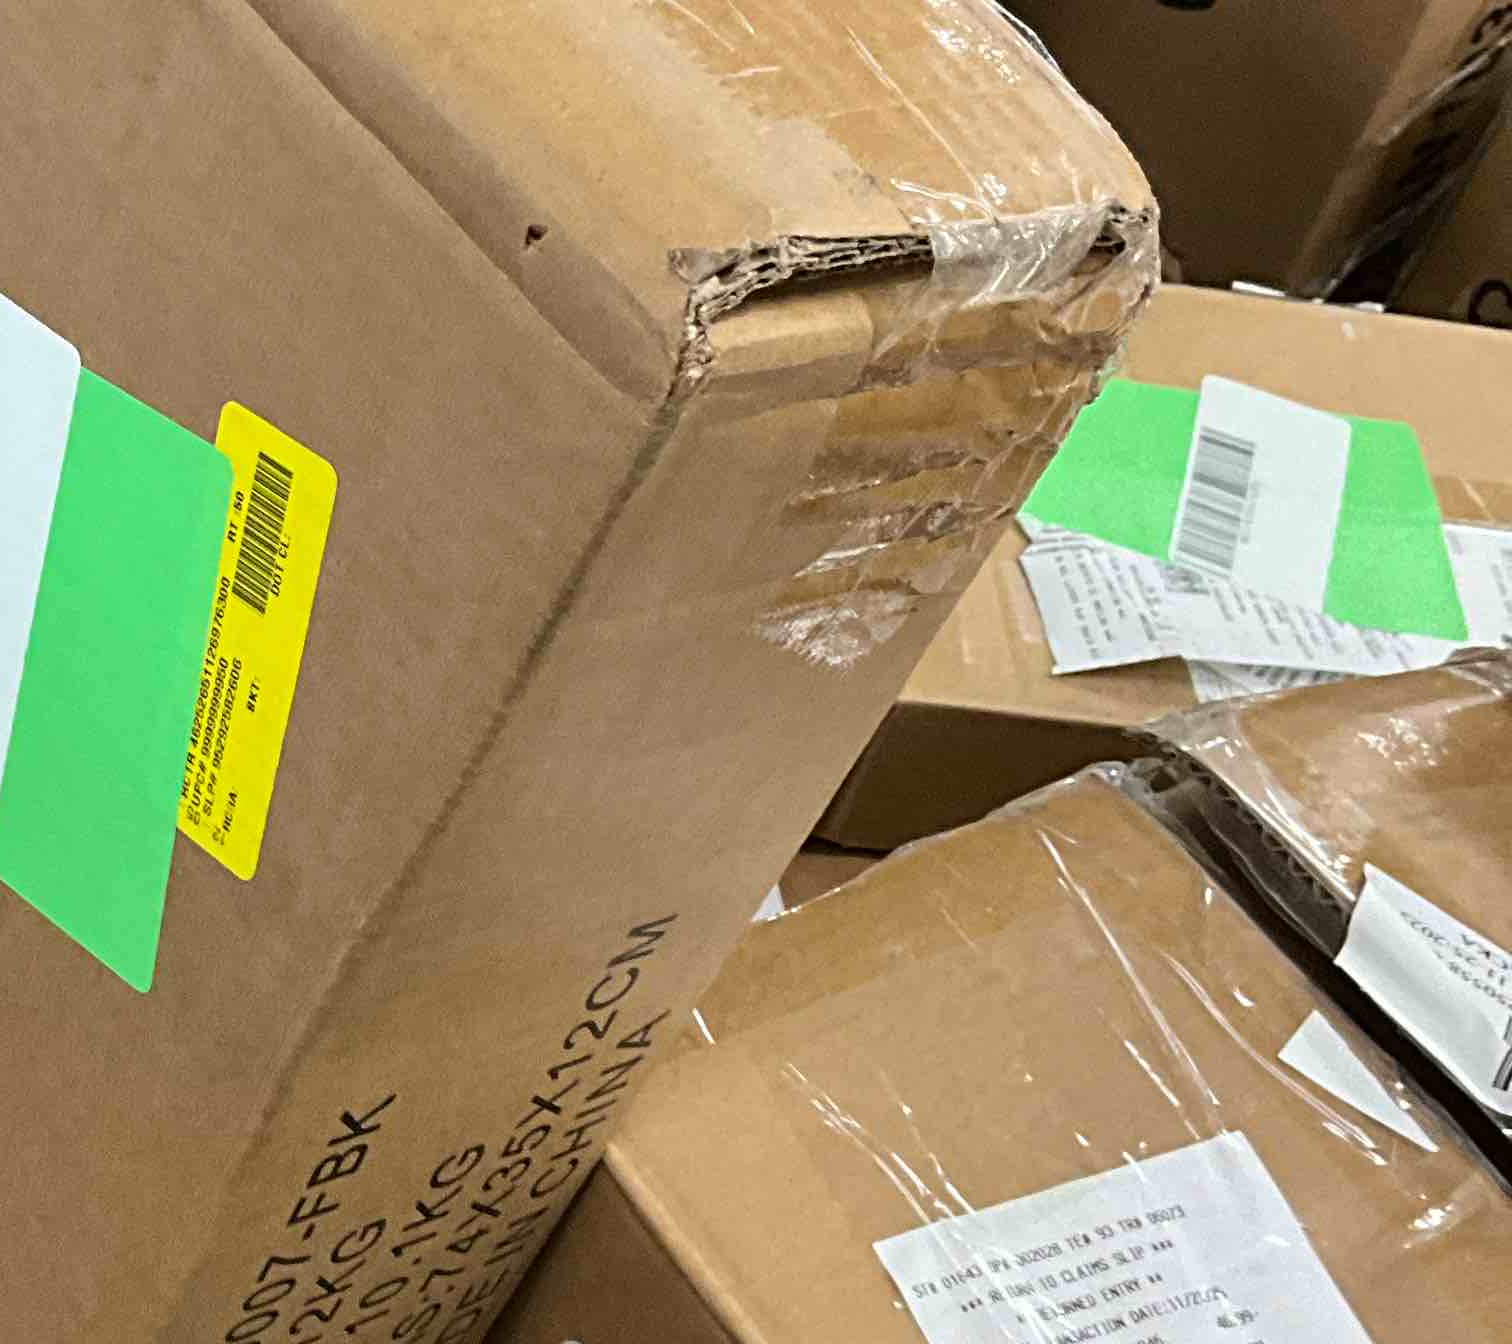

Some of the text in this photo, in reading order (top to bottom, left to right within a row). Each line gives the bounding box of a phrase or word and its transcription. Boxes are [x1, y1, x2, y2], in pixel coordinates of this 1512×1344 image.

[343, 1142, 485, 1335] 10.1KG
[493, 1205, 551, 1262] IN
[531, 1008, 672, 1204] CHINA
